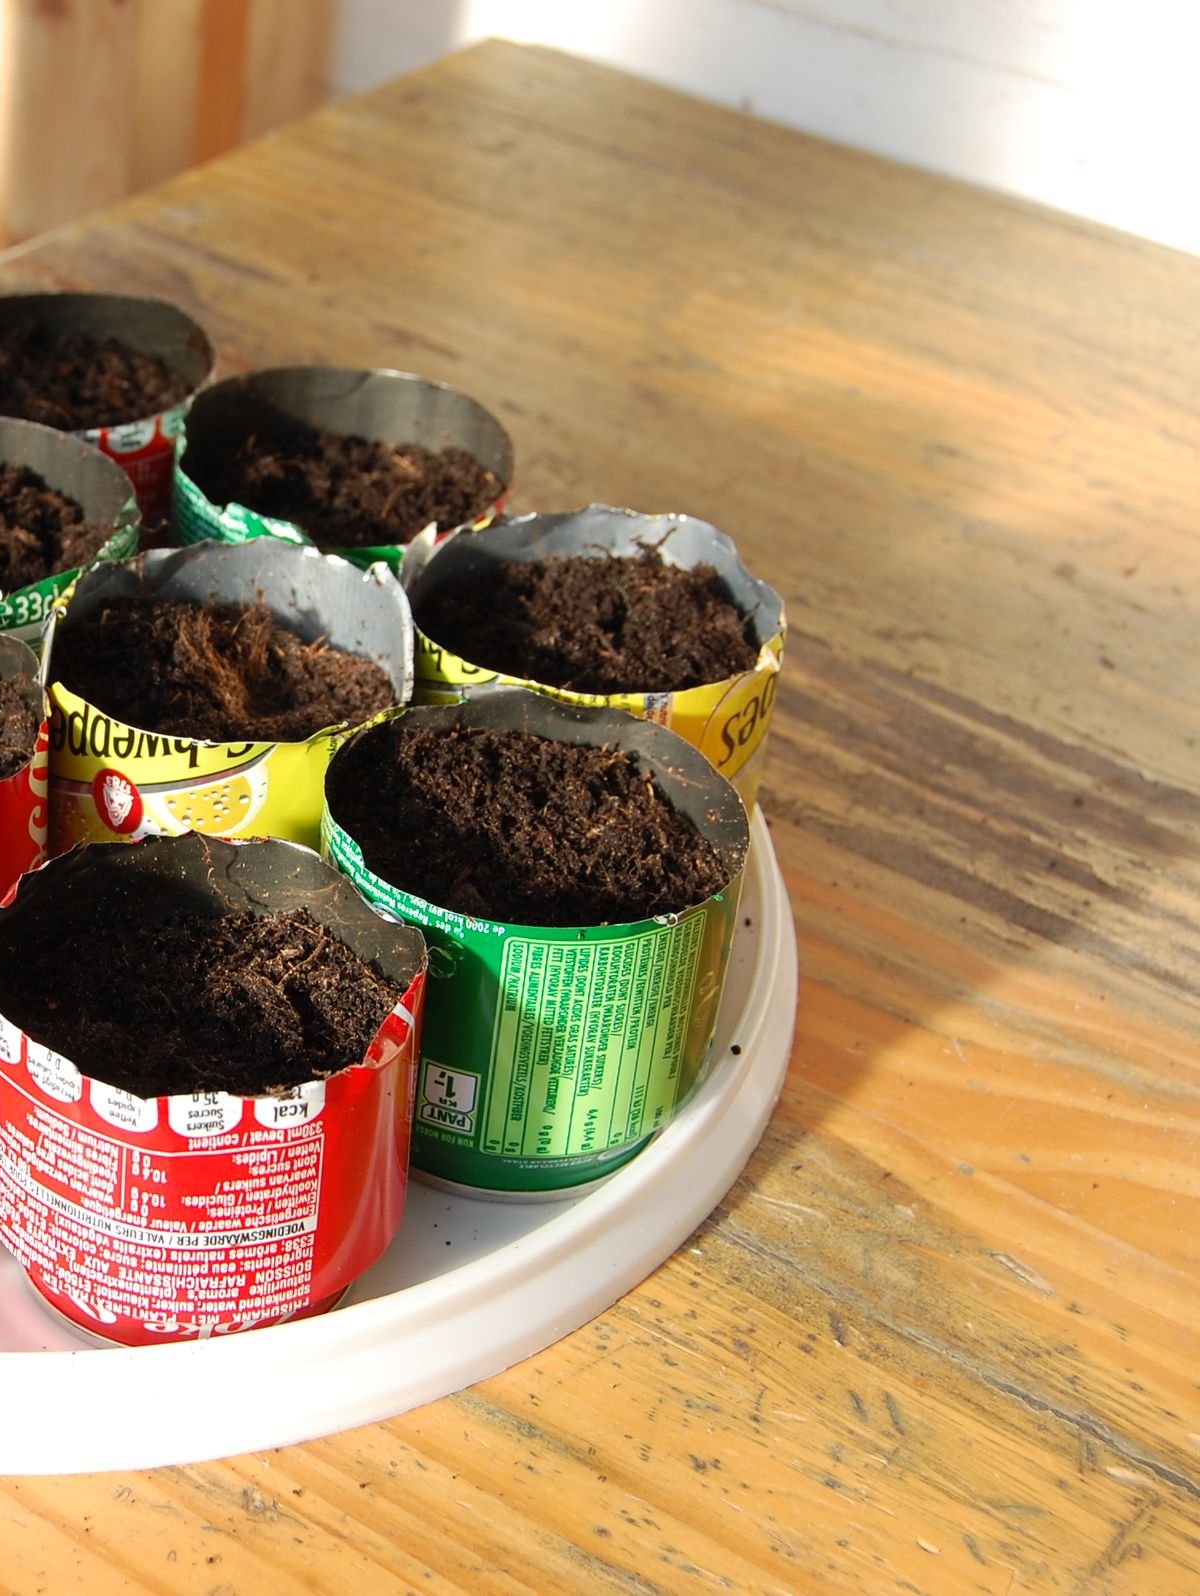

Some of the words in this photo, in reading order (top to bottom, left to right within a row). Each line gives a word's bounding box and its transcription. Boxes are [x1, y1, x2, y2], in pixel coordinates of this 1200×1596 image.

[435, 920, 451, 934] des
[445, 912, 464, 927] kcal
[466, 920, 490, 934] 2000
[492, 925, 505, 937] de
[531, 946, 545, 969] FIBRES
[553, 948, 564, 963] FETT
[578, 948, 591, 973] LIPIDES
[621, 943, 635, 977] GLUCIDES
[571, 1000, 585, 1023] ACIDES
[568, 1024, 581, 1043] GRAS
[273, 1102, 308, 1122] kcal
[439, 1098, 457, 1108] KR
[187, 1106, 224, 1119] Sucres
[427, 1108, 466, 1128] PANT
[186, 1119, 225, 1133] Suikers
[288, 1121, 324, 1142] 330ml
[78, 1130, 119, 1160] Natrium
[188, 1134, 240, 1151] contient
[250, 1129, 285, 1143] bevat
[232, 1149, 278, 1166] Lipides:
[288, 1141, 321, 1159] Vetten
[84, 1147, 118, 1172] Fibres
[293, 1154, 318, 1171] dont
[142, 1168, 167, 1184] 10.6
[248, 1161, 291, 1177] sucres:
[269, 1167, 317, 1187] waarvan
[90, 1175, 114, 1194] dont
[223, 1177, 266, 1193] suikers
[246, 1178, 318, 1203] Koolhydraten
[29, 1182, 111, 1232] NUTRITIONNELLES
[141, 1192, 167, 1208] 10.6
[181, 1194, 236, 1208] Glucides:
[274, 1191, 317, 1211] Eiwitten
[207, 1204, 265, 1218] Protéines:
[245, 1204, 316, 1228] Energetische
[149, 1219, 187, 1233] Valeur
[198, 1219, 243, 1232] waarde
[203, 1221, 306, 1247] VOEDINGSWAARDE
[115, 1225, 165, 1245] VALEURS
[177, 1235, 199, 1247] PER
[281, 1233, 315, 1252] E338;
[112, 1240, 167, 1262] (extraits
[170, 1247, 225, 1264] naturels
[229, 1243, 278, 1261] arômes
[240, 1247, 314, 1272] Ingrédients:
[84, 1253, 110, 1274] AUX
[212, 1262, 237, 1274] eau
[255, 1260, 313, 1283] BOISSON
[118, 1267, 246, 1292] RAFRAÎCHISSANTE
[249, 1272, 312, 1295] natuurlijke
[187, 1287, 239, 1300] aroma's
[239, 1284, 311, 1312] sprankelend
